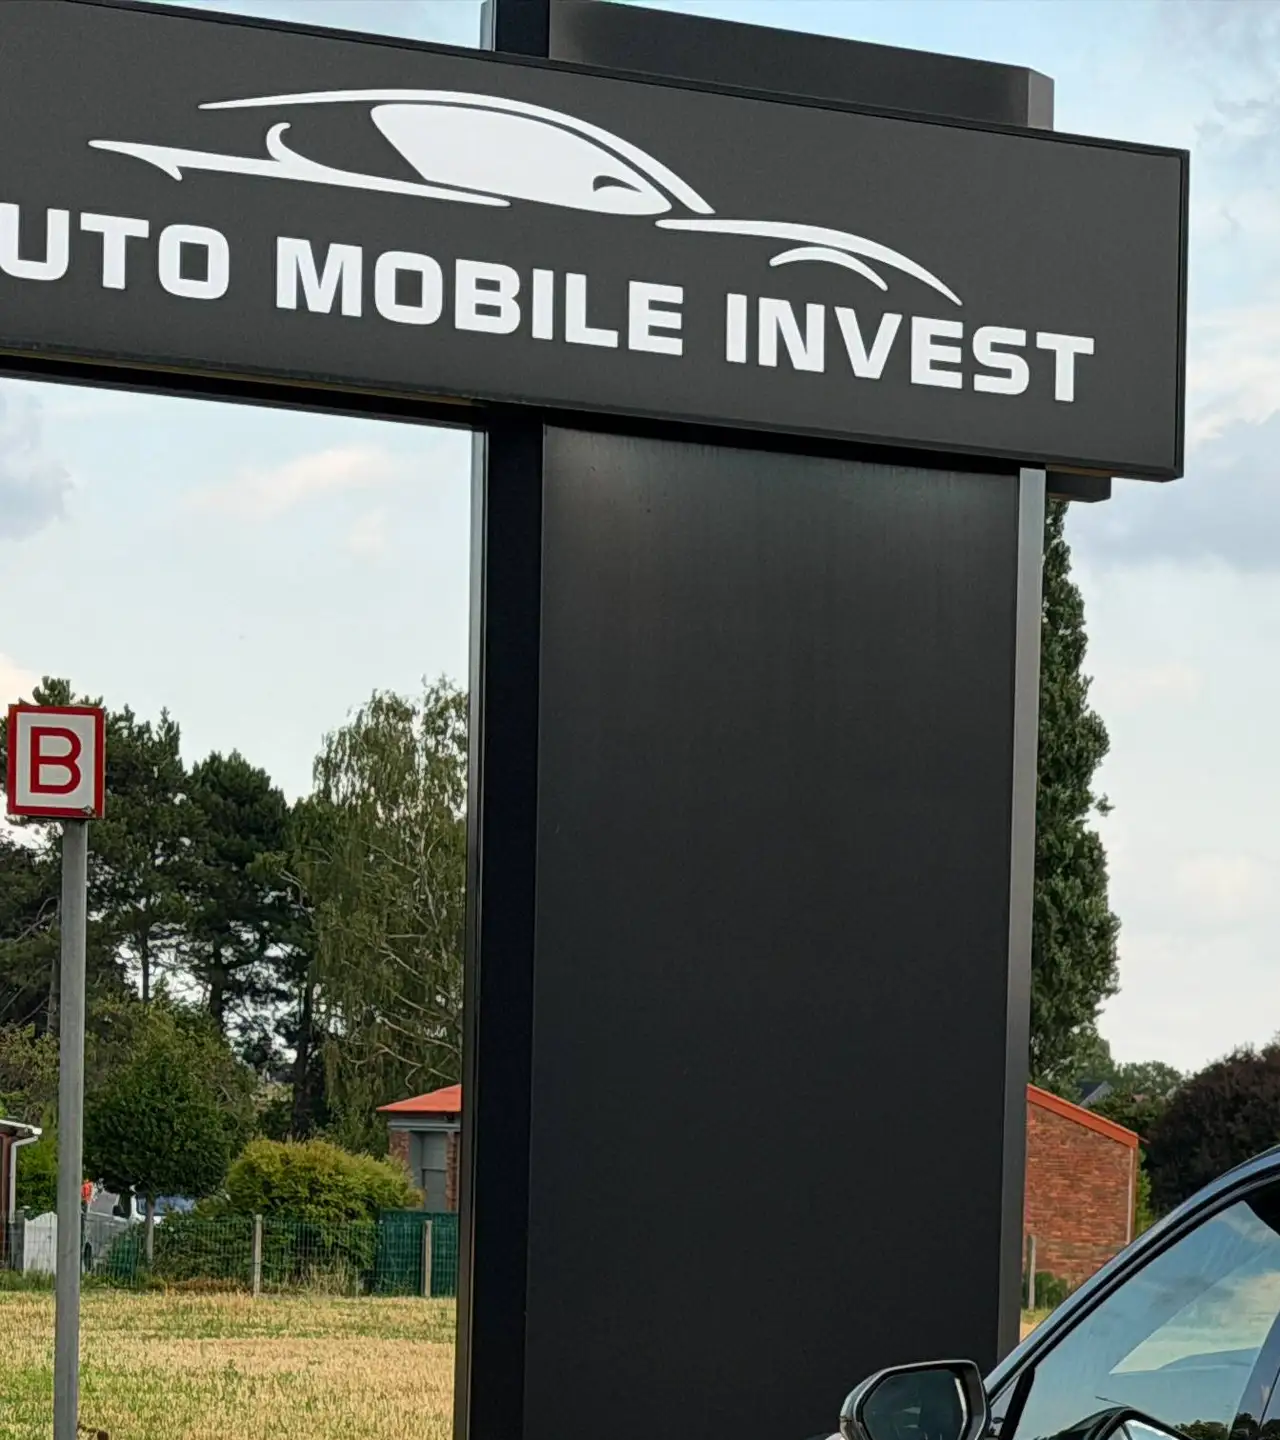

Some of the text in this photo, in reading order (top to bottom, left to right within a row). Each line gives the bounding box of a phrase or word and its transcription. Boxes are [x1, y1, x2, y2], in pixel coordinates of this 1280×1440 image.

[0, 202, 1095, 402] UTO MOBILE INVEST
[29, 727, 81, 796] B
